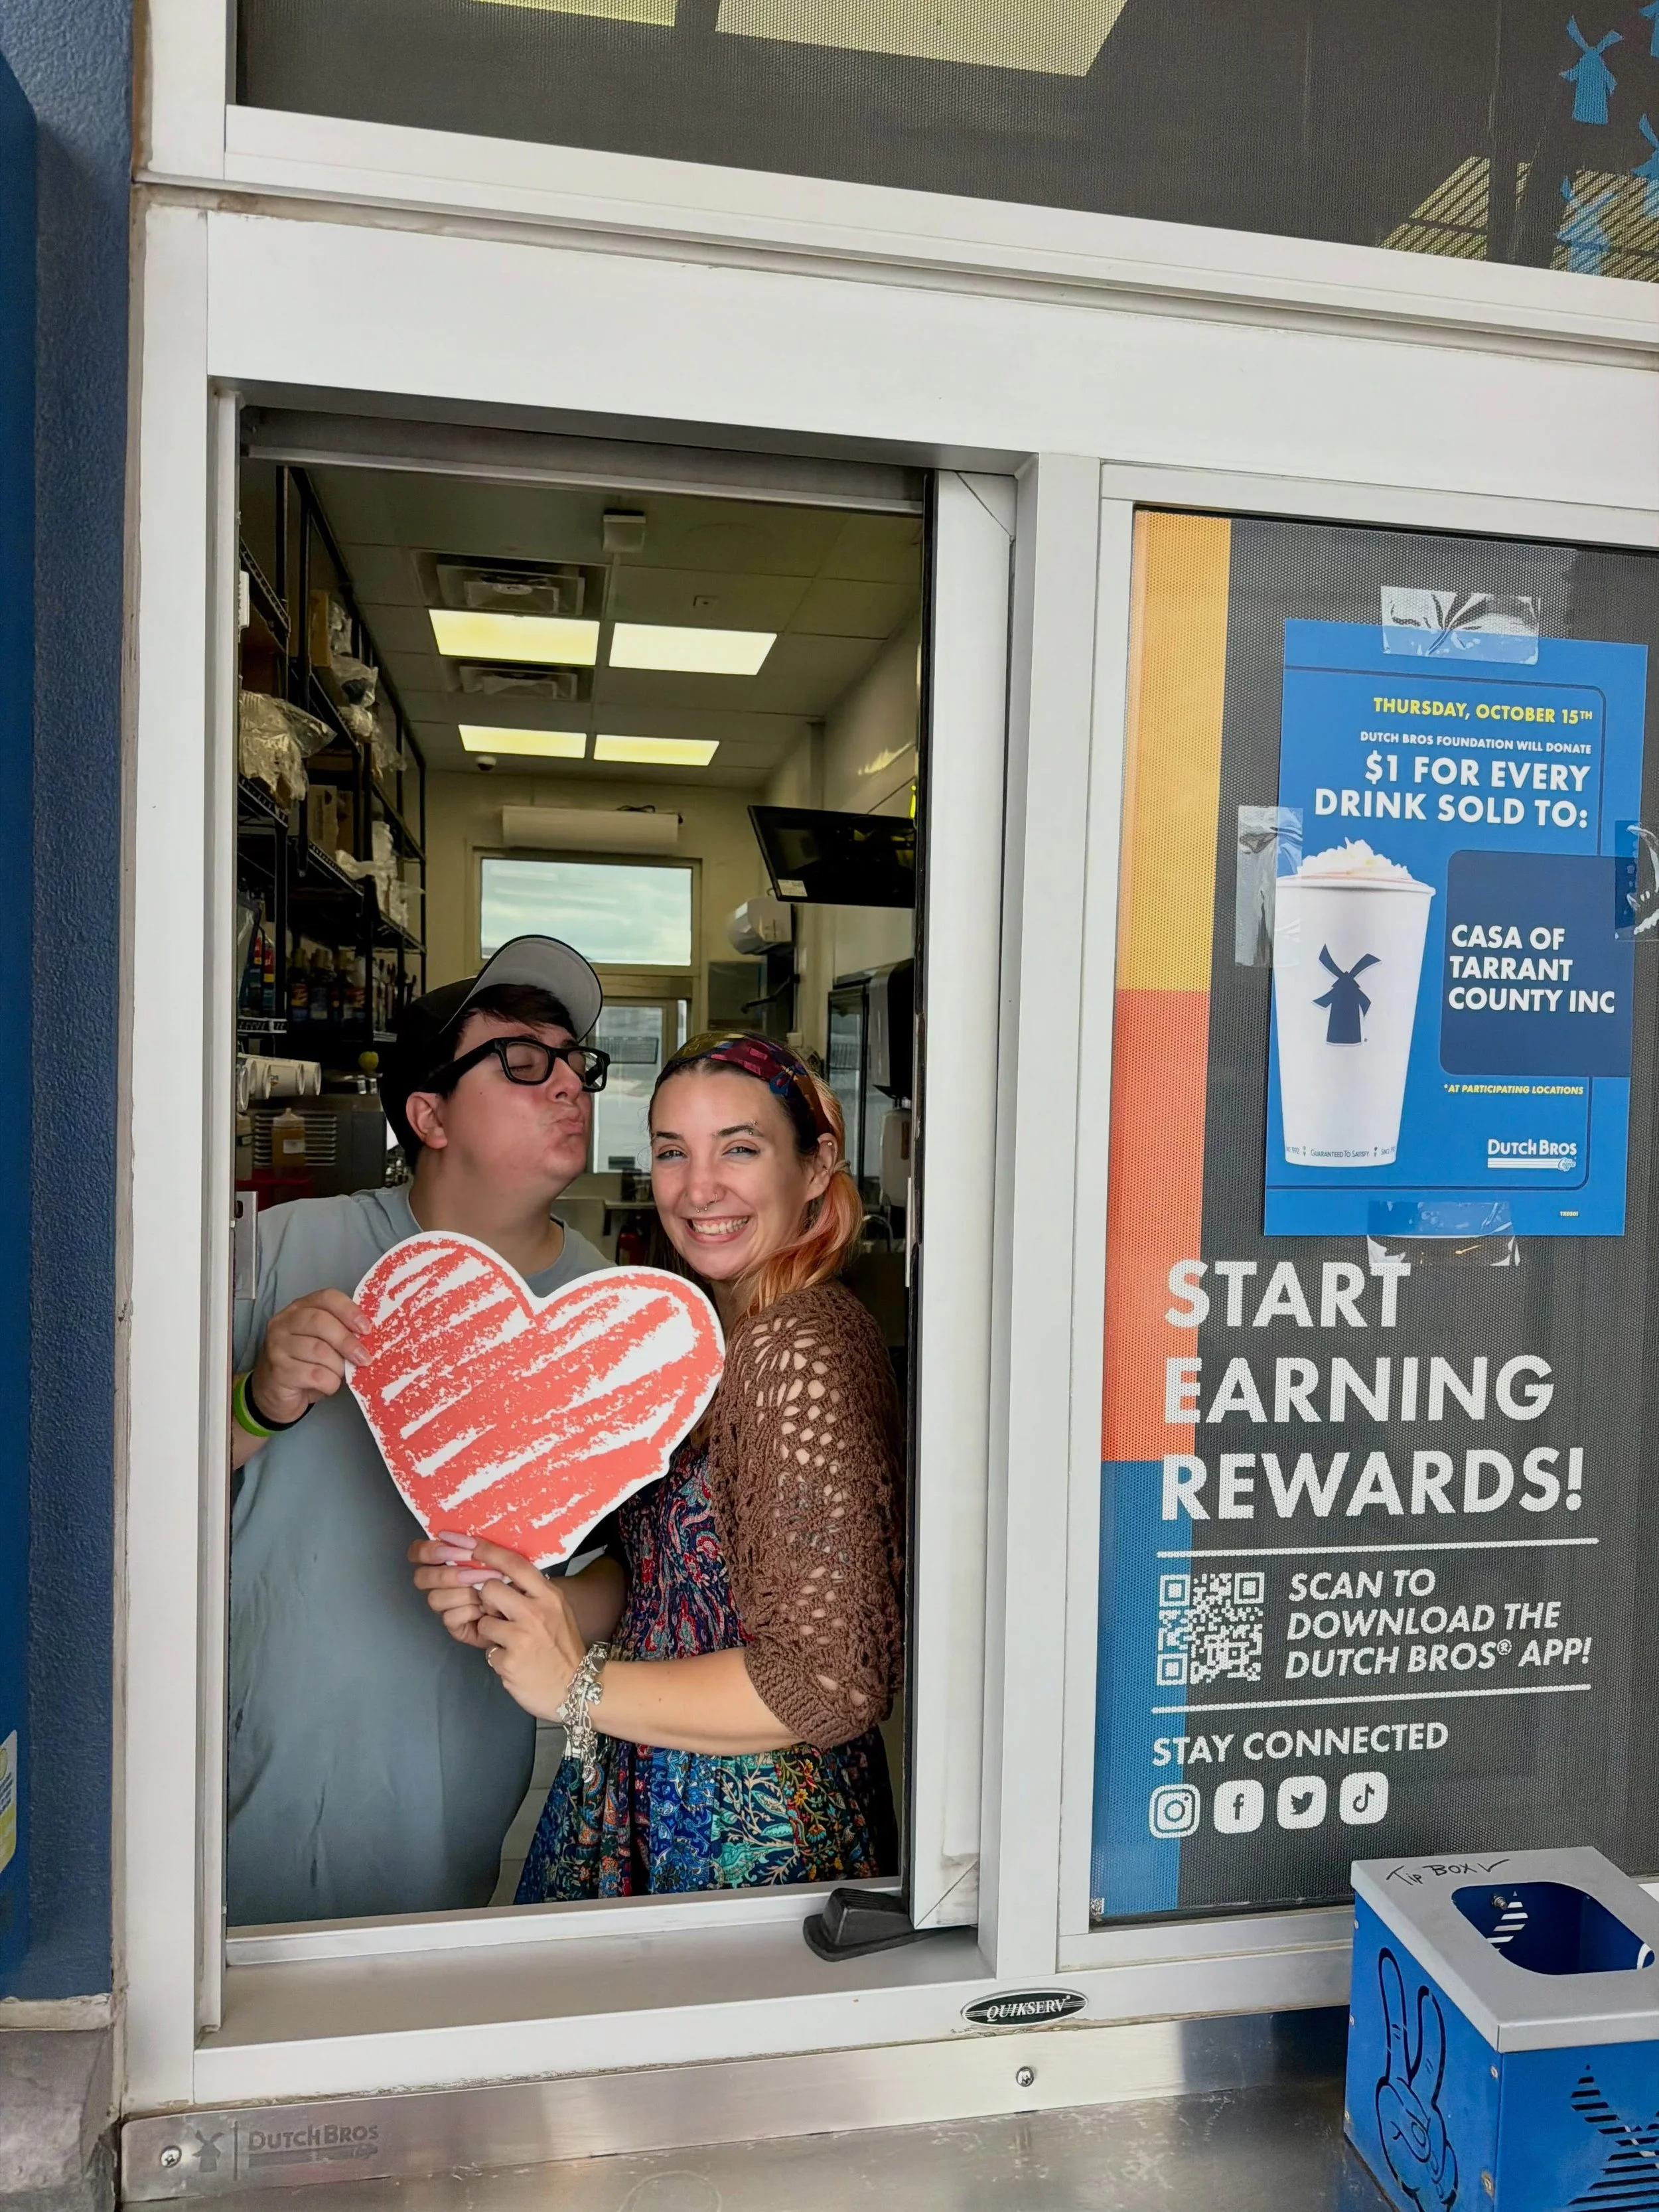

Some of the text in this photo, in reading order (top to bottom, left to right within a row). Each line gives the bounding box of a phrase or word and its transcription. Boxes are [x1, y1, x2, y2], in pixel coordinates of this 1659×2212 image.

[1373, 697, 1470, 720] THURSDAY,
[1475, 702, 1556, 724] OCTOBER
[1359, 731, 1593, 755] DUTCH BROS FOUNDATION WILL DONATE
[1364, 749, 1592, 793] $1 FOR EVERY
[1315, 789, 1589, 830] DRINK SOLD TO:
[1451, 923, 1566, 951] CASA OF
[1449, 954, 1574, 982] TARRANT
[1449, 986, 1615, 1014] COUNTY INC
[1461, 1084, 1530, 1094] PARTICIPATING
[1532, 1086, 1584, 1095] LOCATIONS
[1538, 1139, 1577, 1156] BROS
[1165, 1259, 1411, 1328] START
[1164, 1355, 1554, 1424] EARNING
[1161, 1447, 1583, 1520] REWARDS!
[1289, 1568, 1437, 1603] SCAN TO
[1287, 1601, 1562, 1641] DOWNLOAD THE
[1285, 1649, 1398, 1680] DUTCH
[1518, 1637, 1593, 1668] APP!
[1151, 1722, 1449, 1767] STAY CONNECTED
[324, 2124, 379, 2144] BROS
